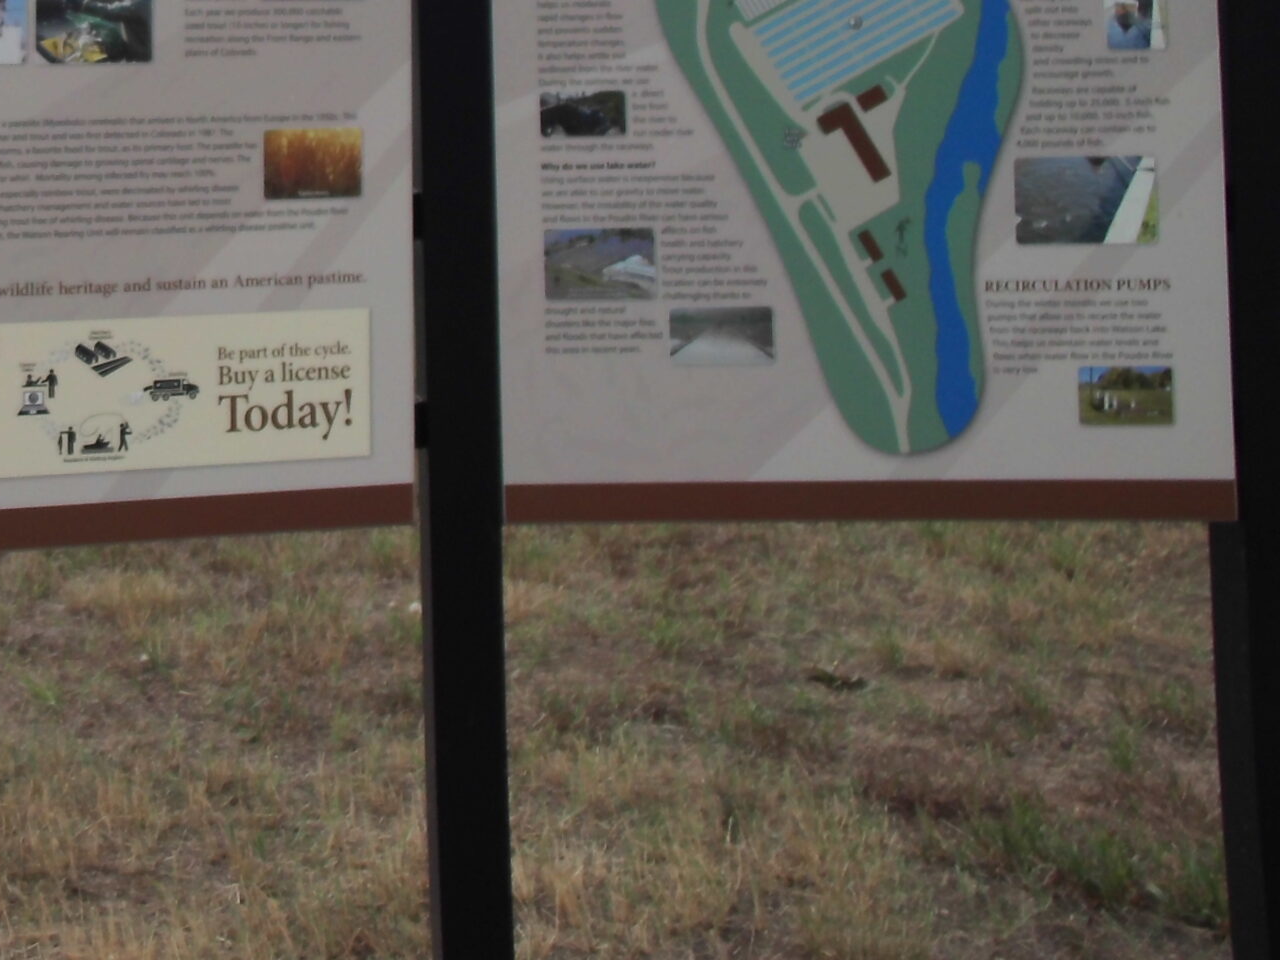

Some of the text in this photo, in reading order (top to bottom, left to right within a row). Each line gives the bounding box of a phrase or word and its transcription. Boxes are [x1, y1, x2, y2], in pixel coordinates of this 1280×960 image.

[57, 278, 118, 298] heritage
[122, 276, 152, 292] and
[155, 274, 207, 290] sustain
[210, 277, 229, 288] an
[233, 271, 303, 287] American
[984, 278, 1171, 293] RECIRCULATION PUMPS
[216, 338, 352, 364] Be part of the cycle.
[217, 361, 350, 392] Buy a license
[219, 390, 354, 439] Today!
